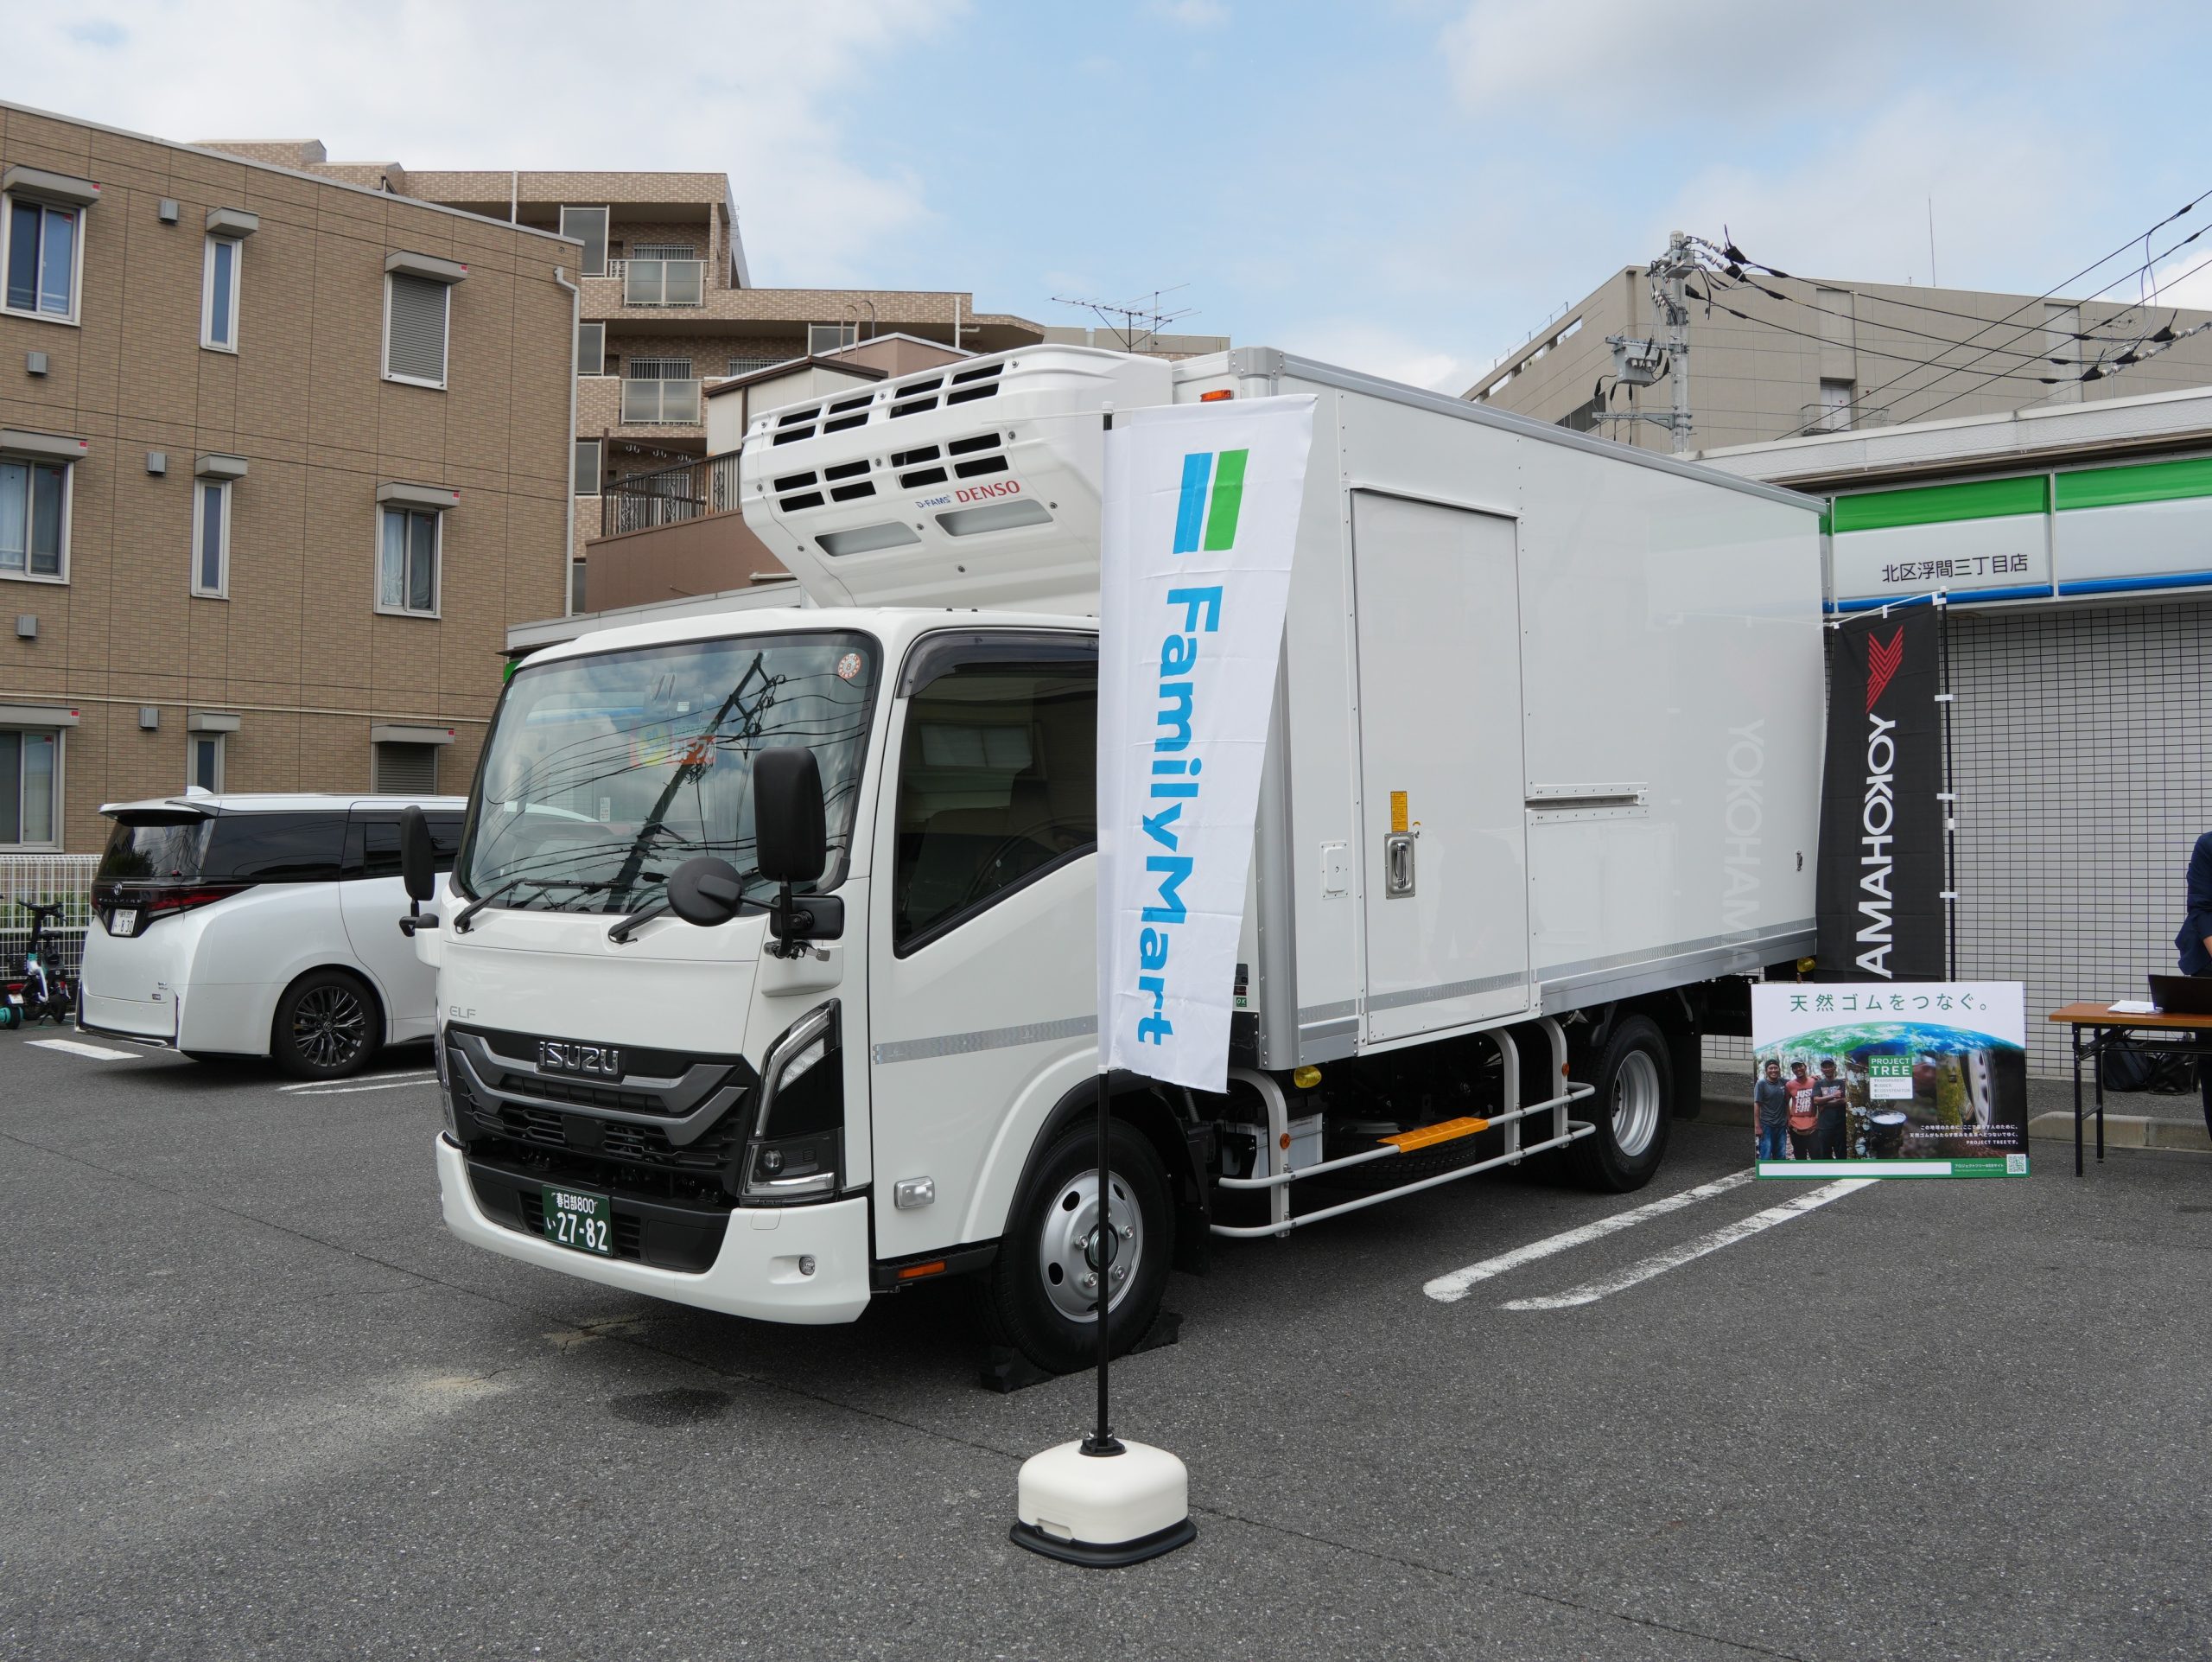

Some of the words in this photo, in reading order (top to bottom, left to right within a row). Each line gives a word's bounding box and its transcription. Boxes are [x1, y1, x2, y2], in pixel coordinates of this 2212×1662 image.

[956, 481, 1020, 503] DENSO
[1882, 553, 2028, 583] 北区浮間三丁目店
[1137, 585, 1224, 1046] FamilyMart
[449, 1005, 476, 1019] ELF
[1789, 993, 1986, 1012] 天然ゴムをつなぐ。
[539, 1041, 620, 1076] ISUZU
[1871, 1066, 1910, 1075] TREE
[556, 1192, 594, 1214] 春日部800
[546, 1216, 556, 1230] い
[556, 1211, 607, 1251] 27-82
